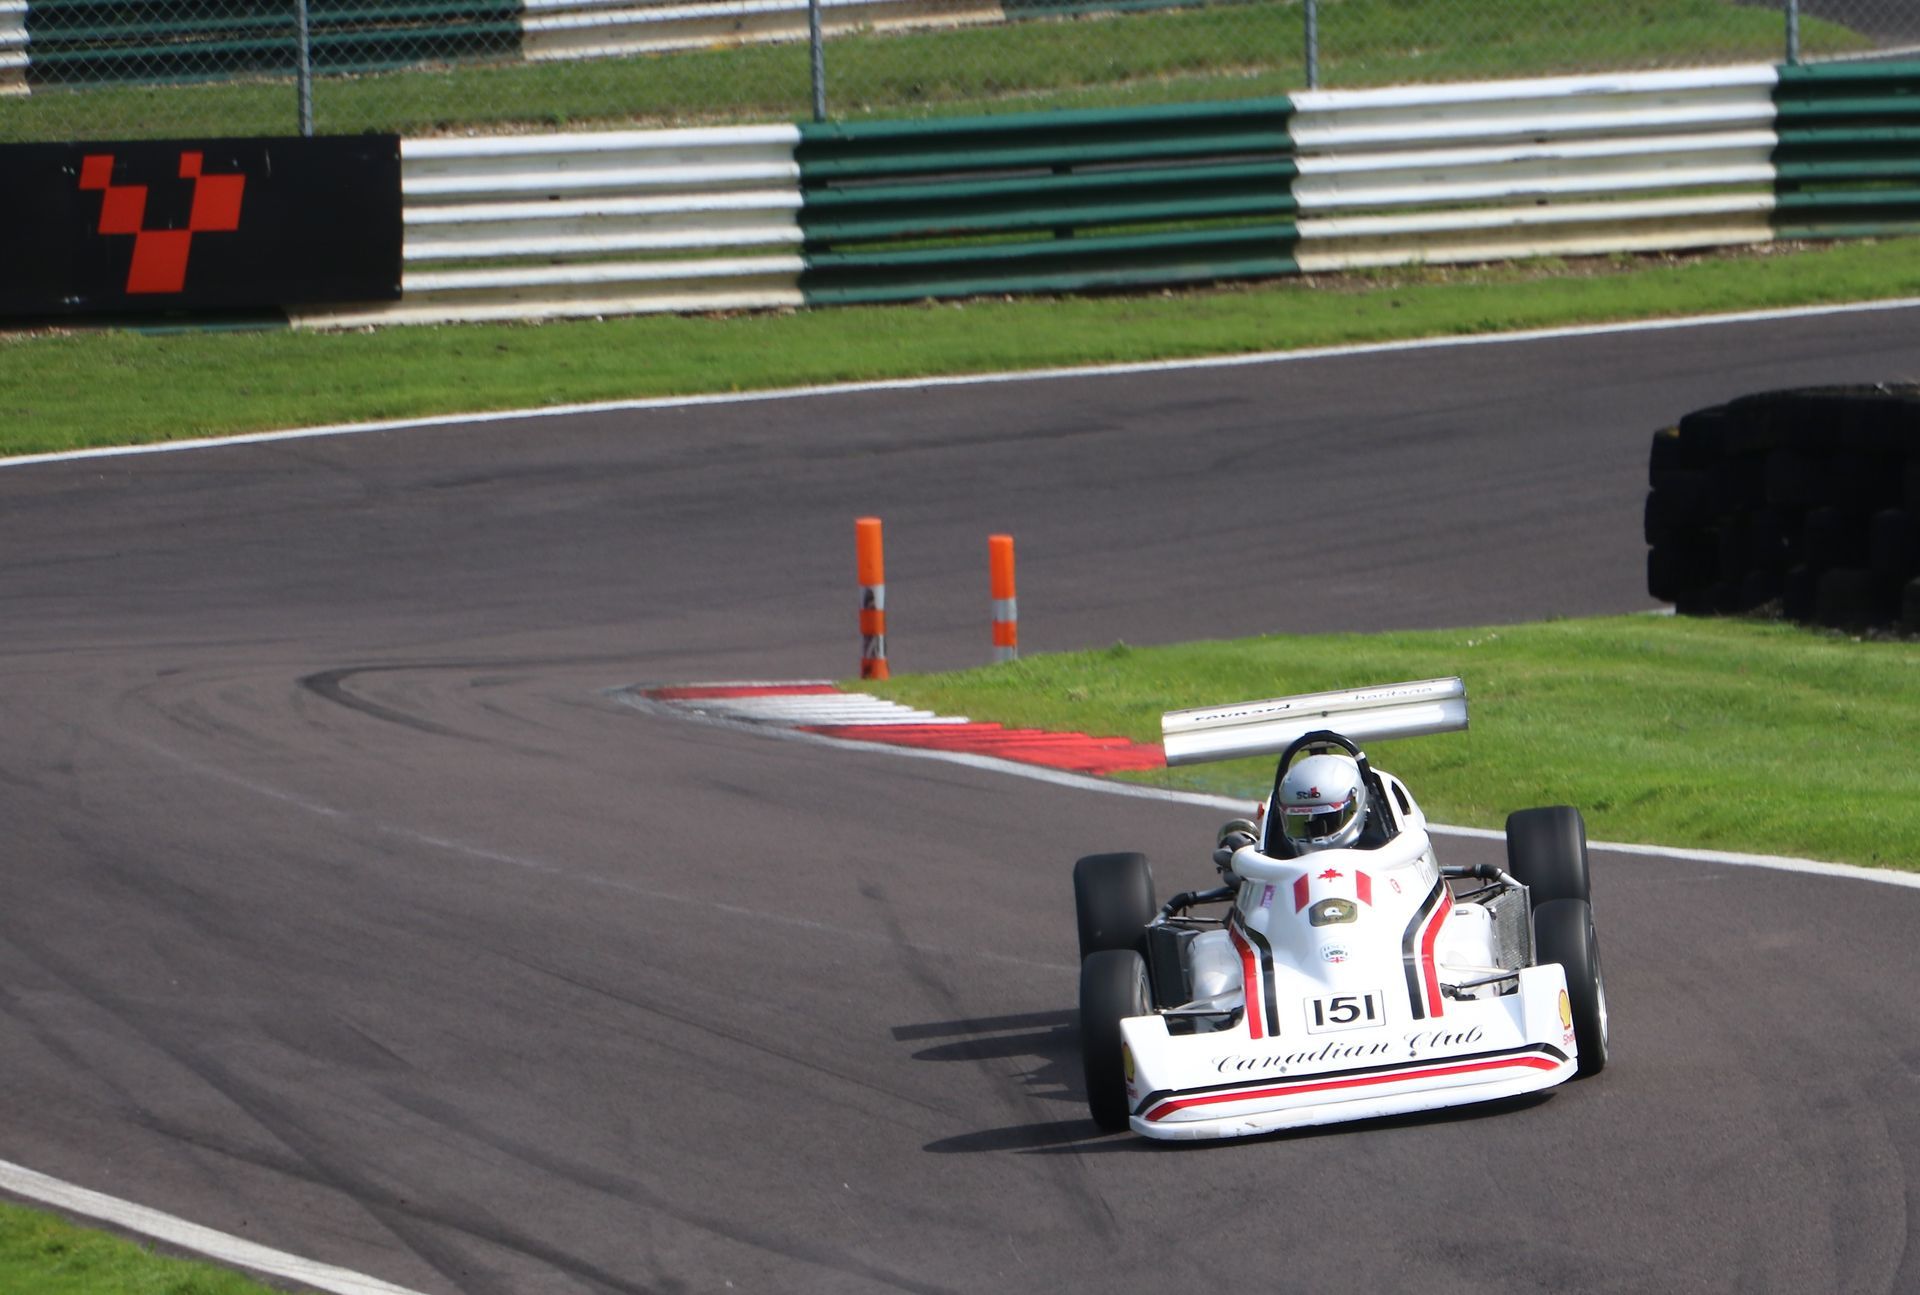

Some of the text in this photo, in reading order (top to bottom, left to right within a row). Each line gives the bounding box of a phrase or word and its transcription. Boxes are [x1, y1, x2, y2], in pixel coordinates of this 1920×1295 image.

[1313, 994, 1376, 1026] 151
[1211, 1024, 1484, 1074] Canadian Club
